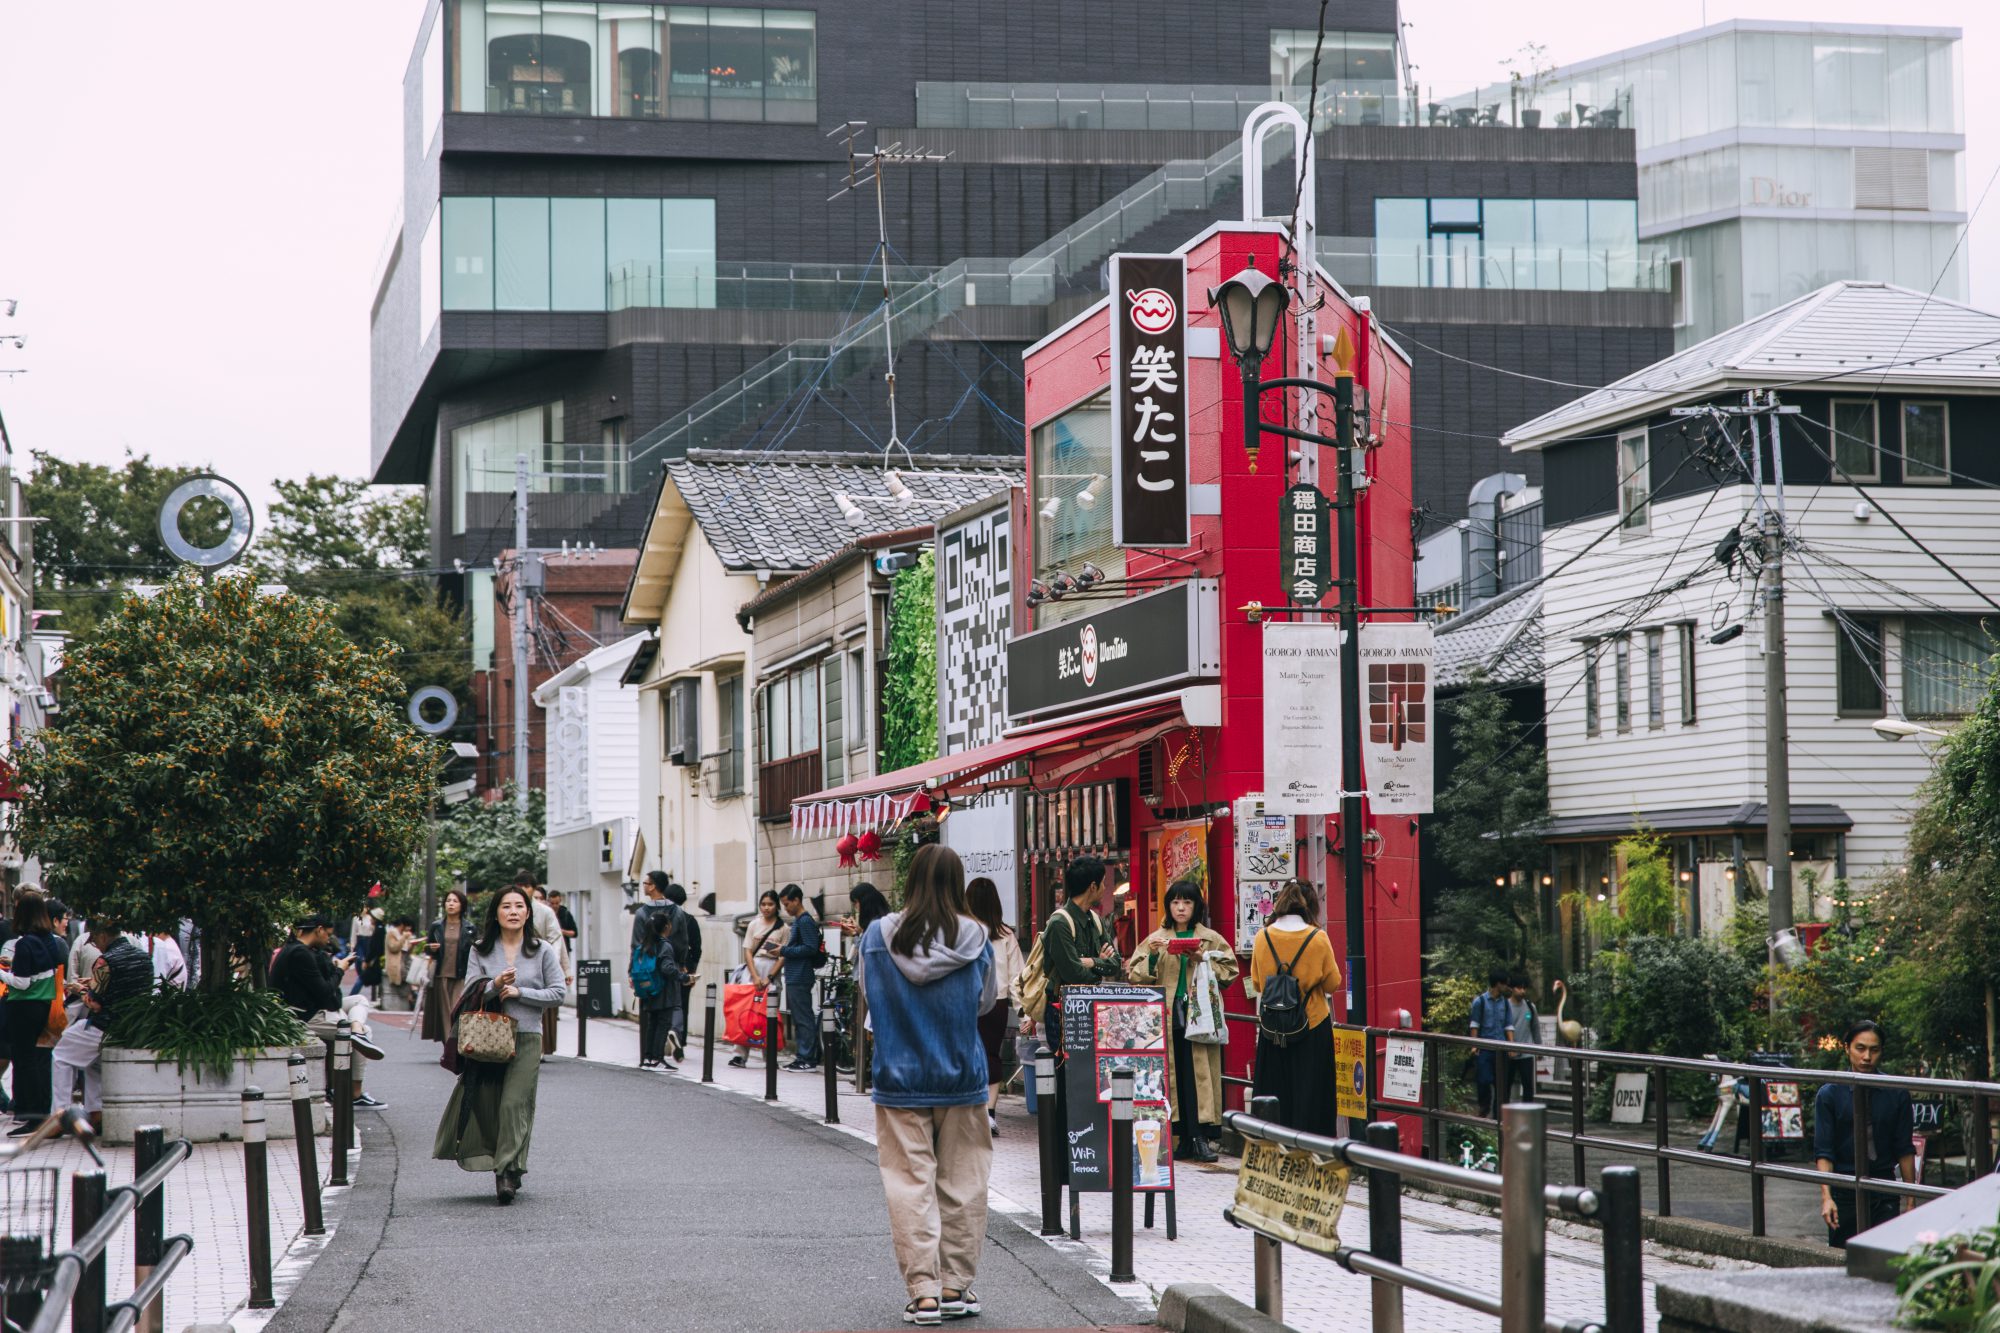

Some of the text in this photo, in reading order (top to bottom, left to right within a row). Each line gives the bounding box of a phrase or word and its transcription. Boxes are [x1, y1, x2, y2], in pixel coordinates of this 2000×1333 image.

[1749, 176, 1812, 208] Dior
[1130, 345, 1178, 492] 笑たこ
[1293, 490, 1318, 599] 穏田商店会
[1059, 637, 1128, 680] 笑たこ WaroTako
[1264, 647, 1338, 657] GIORGIO ARMANI
[1359, 647, 1433, 657] GIORGIO ARMANI
[1279, 671, 1326, 679] Matte Nature
[555, 685, 587, 825] ROXY
[1396, 755, 1417, 763] Nature
[1064, 1000, 1093, 1015] OPEN
[1616, 1089, 1643, 1107] OPEN
[1911, 1103, 1943, 1125] PEN
[1070, 1161, 1100, 1173] Terrace
